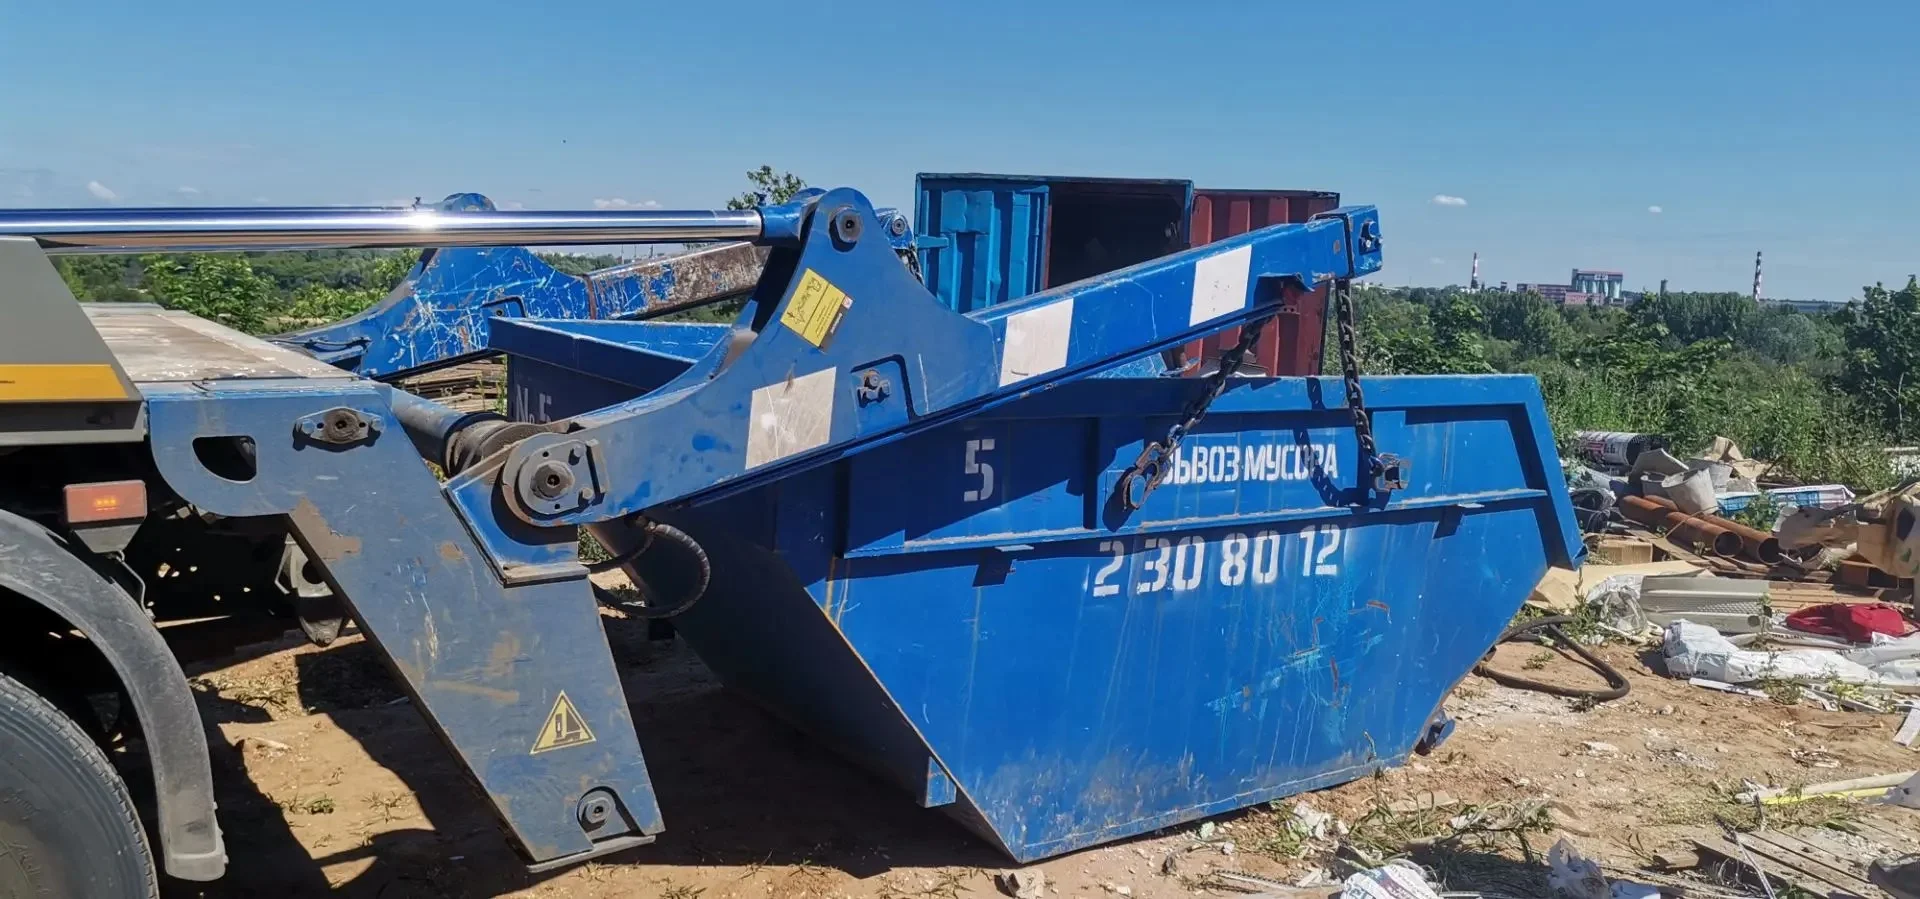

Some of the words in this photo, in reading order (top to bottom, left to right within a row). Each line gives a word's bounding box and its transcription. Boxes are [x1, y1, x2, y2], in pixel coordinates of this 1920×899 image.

[964, 439, 995, 502] 5
[1244, 444, 1338, 481] МУСОРА
[1093, 541, 1124, 597] 2
[1137, 536, 1205, 594] 30
[1220, 531, 1280, 586] 80
[1300, 524, 1341, 576] 12
